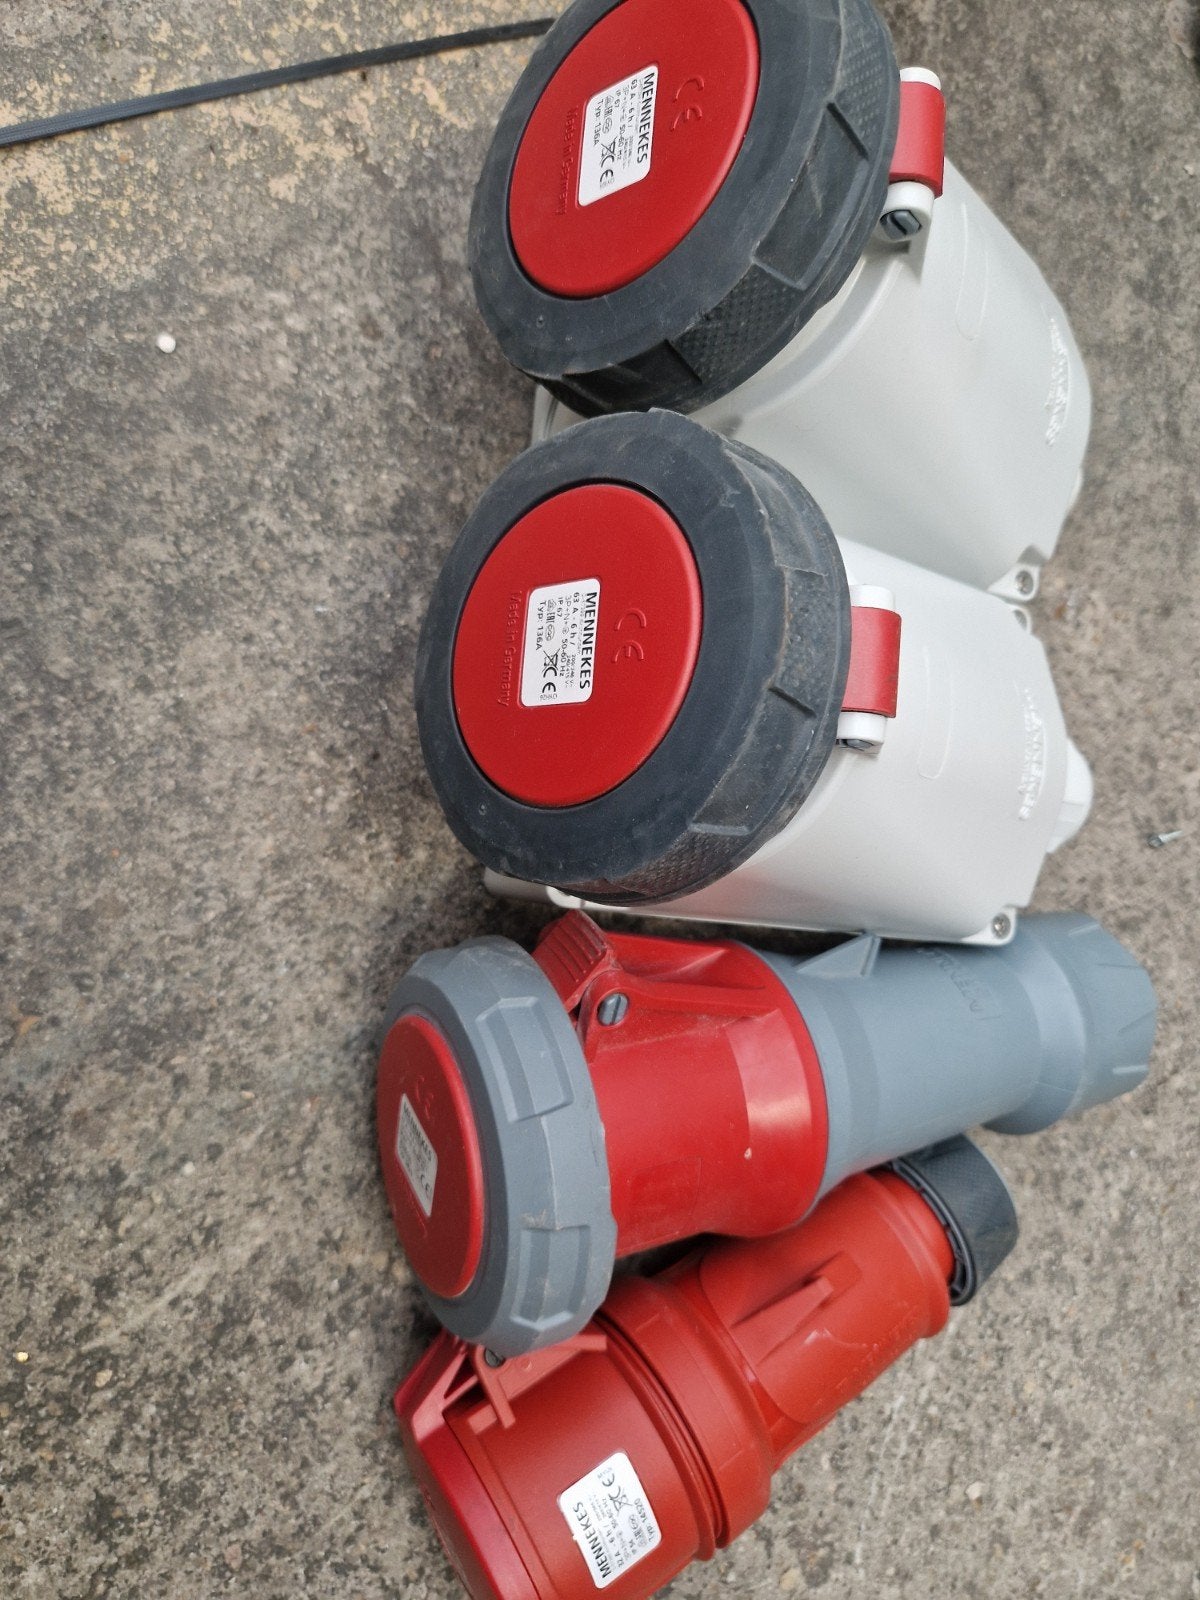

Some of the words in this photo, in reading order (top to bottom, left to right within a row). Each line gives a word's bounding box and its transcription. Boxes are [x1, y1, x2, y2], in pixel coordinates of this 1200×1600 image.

[631, 79, 638, 90] 63
[564, 105, 578, 142] Made
[637, 72, 655, 164] MENNEKES
[563, 145, 576, 156] in
[555, 159, 574, 216] Germany
[508, 591, 522, 629] Made
[573, 592, 580, 603] 63
[538, 600, 546, 622] Typ:
[556, 607, 563, 617] 67
[505, 631, 519, 643] in
[536, 625, 544, 650] 136A
[579, 592, 597, 690] MENNEKES
[560, 638, 568, 662] 50-60
[498, 647, 516, 707] Germany
[542, 666, 557, 694] CE
[559, 666, 567, 677] Hz
[634, 1498, 648, 1523] 14520
[572, 1502, 612, 1578] MENNEKES
